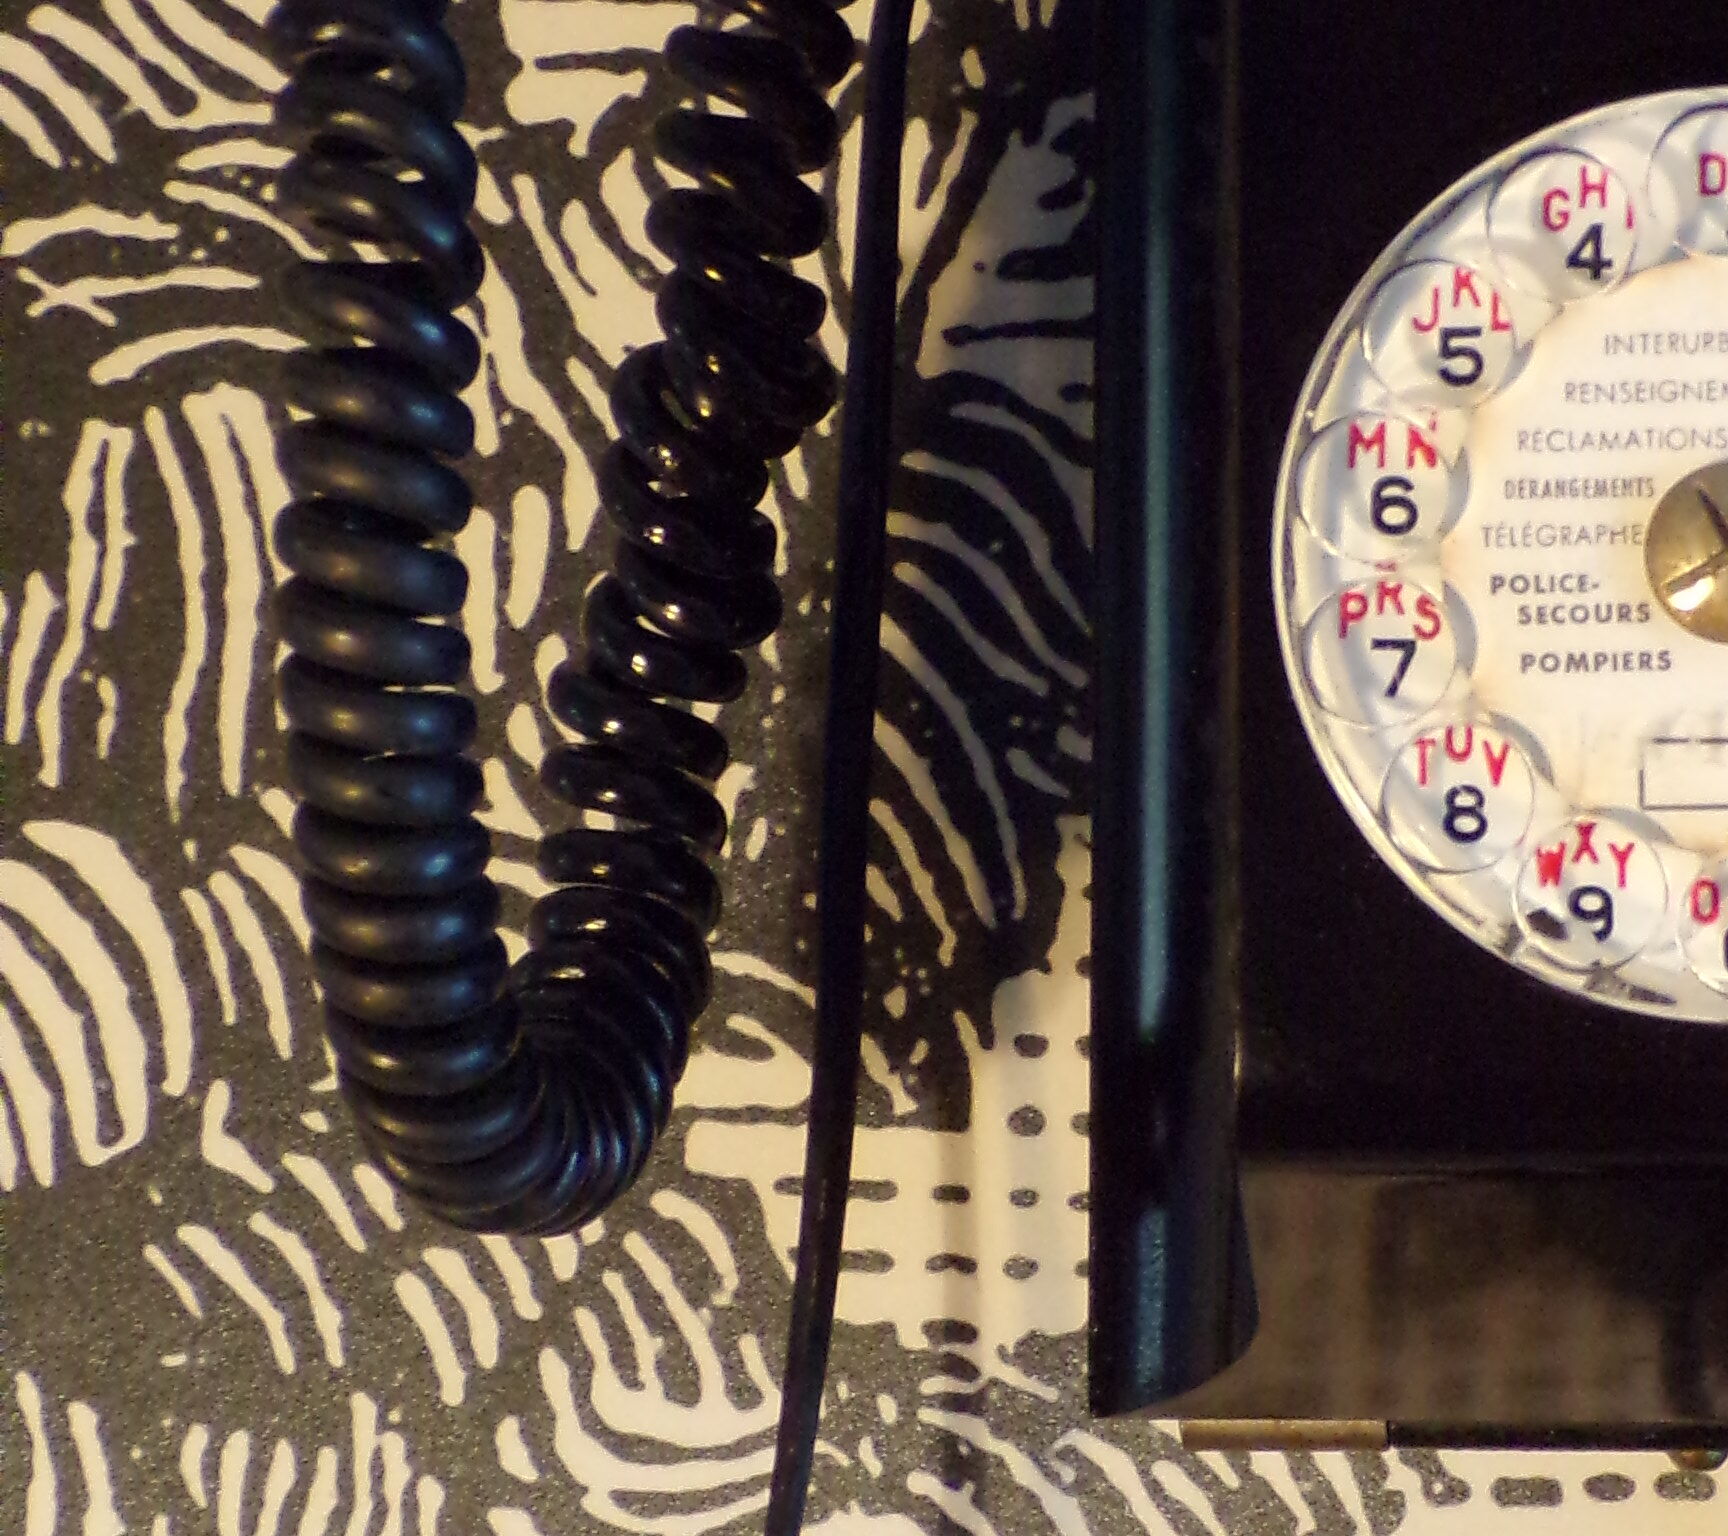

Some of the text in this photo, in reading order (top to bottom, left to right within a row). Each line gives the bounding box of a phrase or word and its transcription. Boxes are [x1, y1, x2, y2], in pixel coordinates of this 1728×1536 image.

[1565, 221, 1614, 281] 4
[1411, 266, 1512, 335] JKL
[1438, 325, 1484, 386] 5
[1370, 475, 1418, 535] 6
[1489, 573, 1601, 596] POLICE-
[1517, 601, 1651, 626] SECOURS
[1369, 637, 1418, 698] 7
[1520, 649, 1674, 675] POMPIERS
[1413, 723, 1510, 788] TUV
[1442, 784, 1489, 844] 8
[1568, 885, 1614, 943] 9
